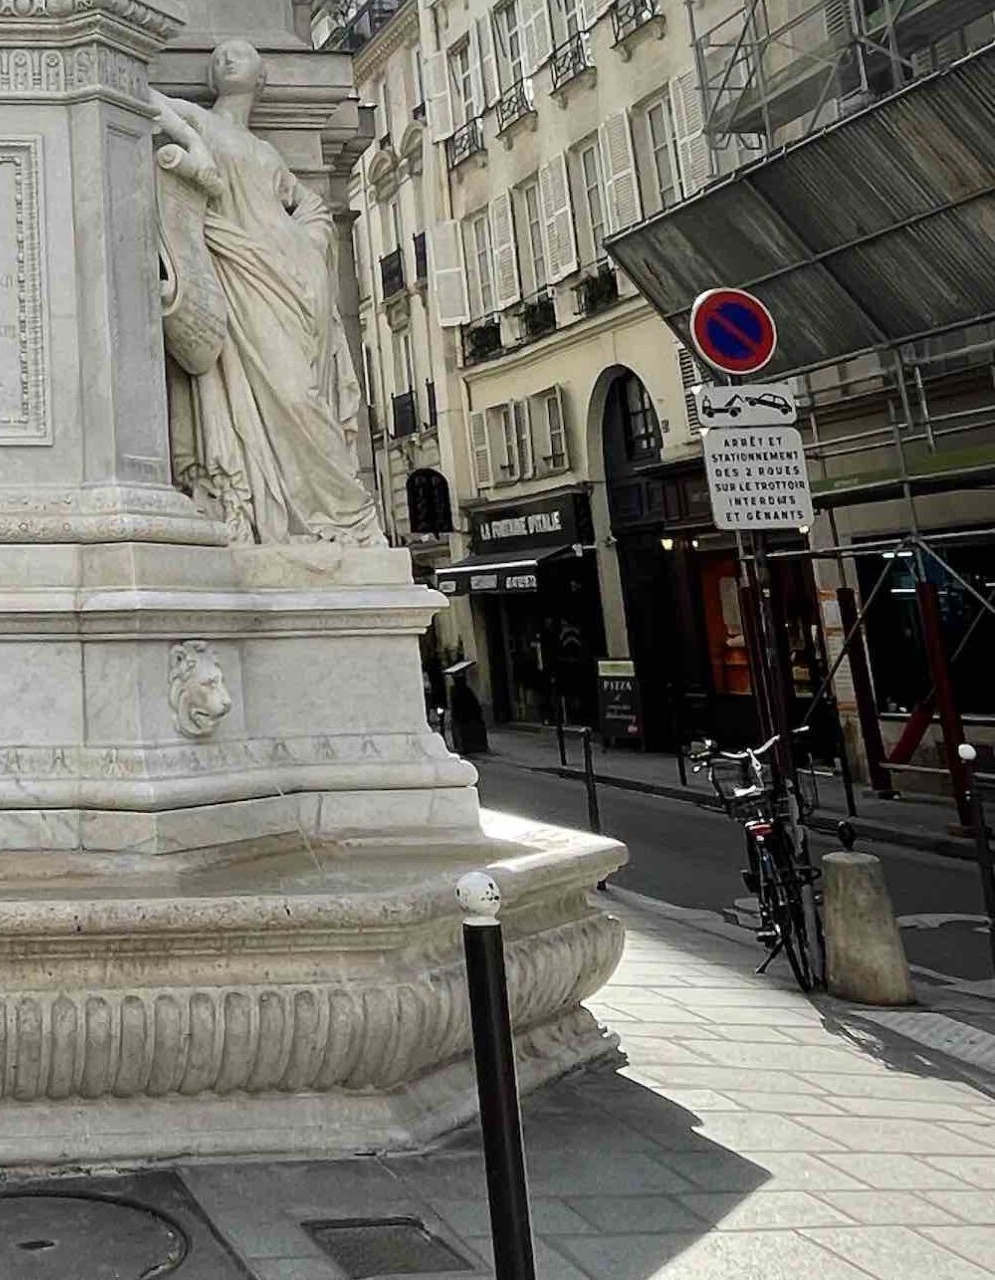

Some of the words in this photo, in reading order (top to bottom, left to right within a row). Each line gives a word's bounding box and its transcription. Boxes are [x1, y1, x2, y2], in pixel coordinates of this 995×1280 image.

[768, 436, 782, 447] ET
[711, 450, 798, 463] STATIONNEMENT
[715, 467, 739, 478] DES
[745, 467, 753, 477] 2
[758, 465, 800, 476] ROUES
[715, 482, 736, 492] SUR
[739, 481, 752, 491] LE
[754, 480, 805, 491] TROTTOIR
[728, 495, 796, 507] INTERDITS
[726, 512, 740, 522] ET
[746, 510, 805, 521] GÊNANTS
